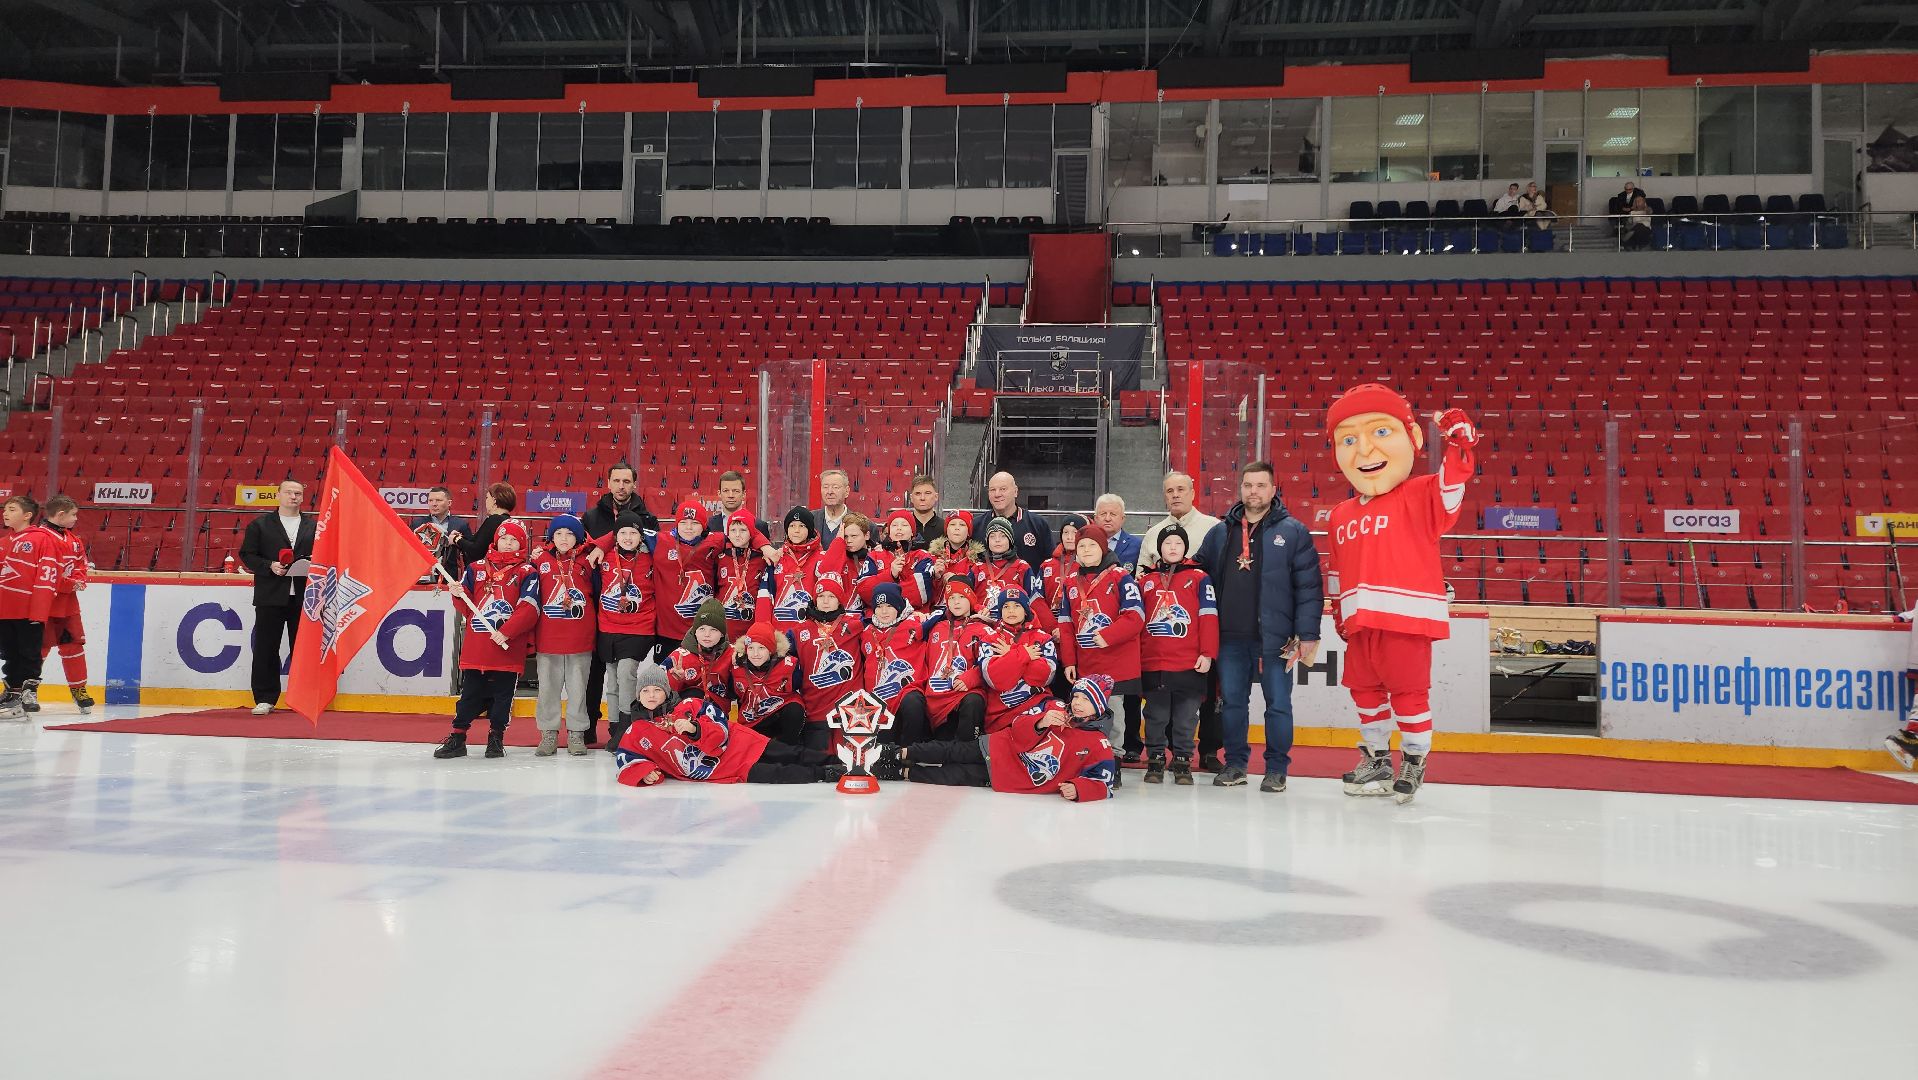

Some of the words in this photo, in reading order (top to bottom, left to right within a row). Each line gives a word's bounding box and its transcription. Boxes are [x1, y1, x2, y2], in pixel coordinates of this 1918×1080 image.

[1016, 335, 1051, 343] ТОЛЬКО
[97, 487, 149, 499] KHL.RU
[1336, 514, 1389, 545] СССР
[40, 565, 58, 583] 32
